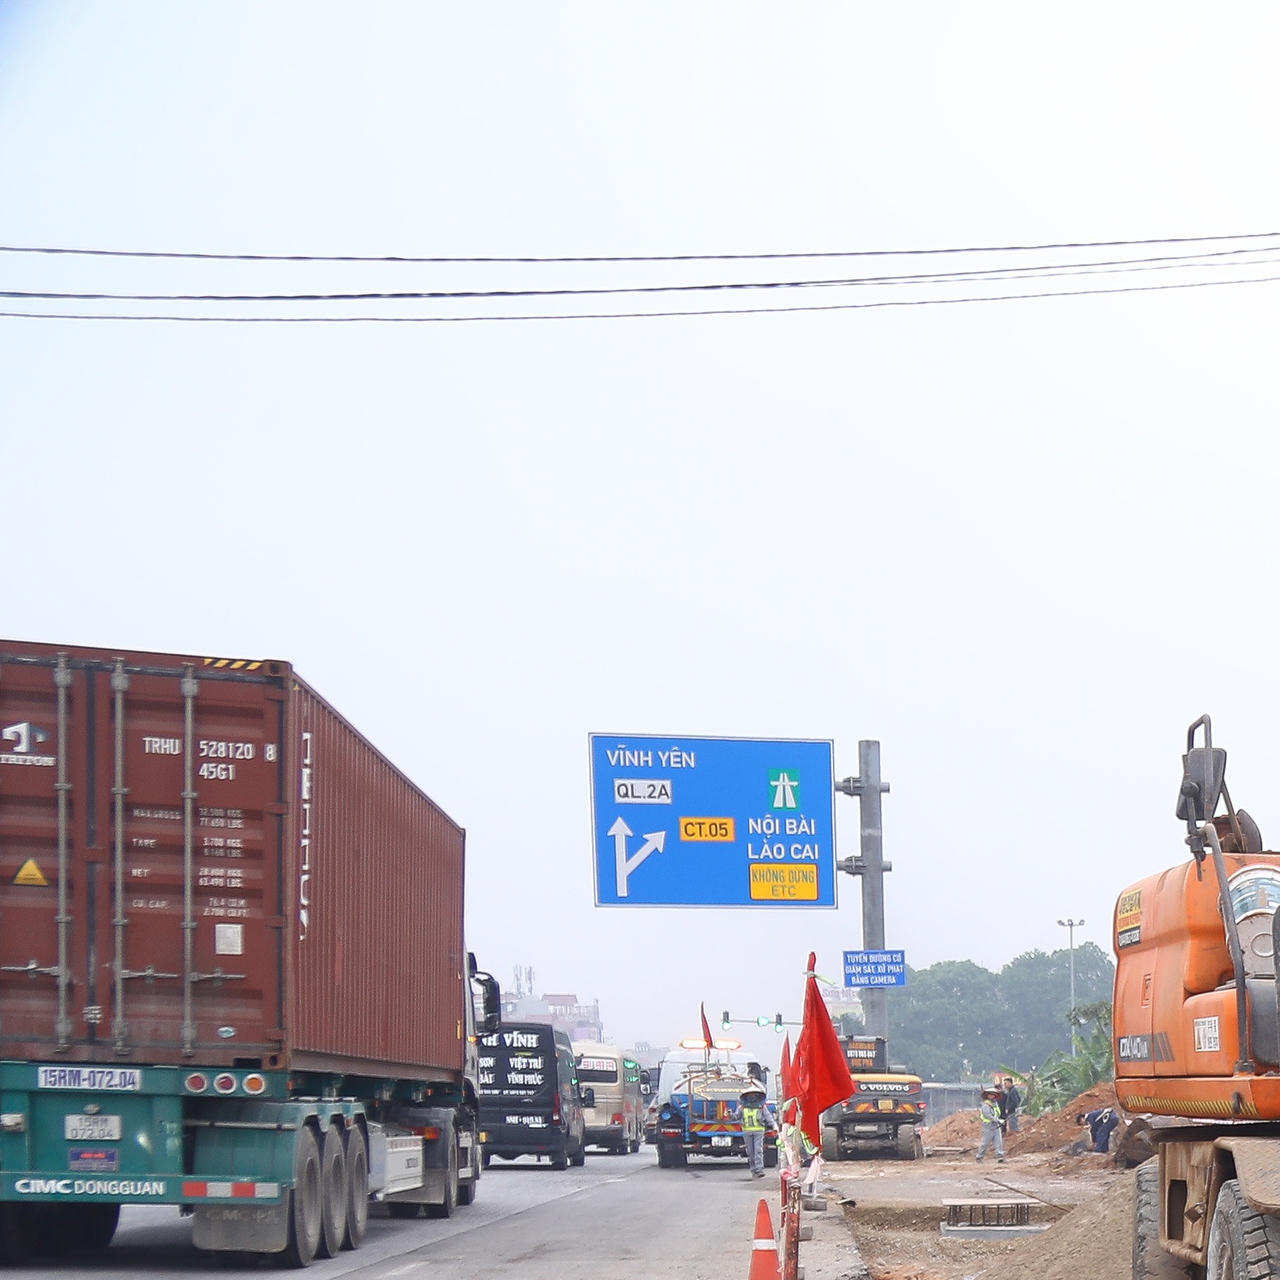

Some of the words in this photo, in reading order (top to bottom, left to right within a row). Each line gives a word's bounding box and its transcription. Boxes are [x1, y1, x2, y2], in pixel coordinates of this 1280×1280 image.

[142, 737, 182, 755] TRHU
[199, 740, 255, 760] 528120
[265, 743, 278, 762] 8
[606, 744, 653, 767] VĨNH
[657, 746, 696, 768] YÊN
[199, 763, 236, 780] 45G1
[616, 783, 670, 799] QL.2A
[684, 822, 728, 838] CT.05
[748, 815, 780, 839] NỘI
[785, 814, 816, 836] BÀI
[747, 839, 786, 860] LÀO
[790, 843, 819, 860] CAI
[752, 867, 785, 883] KHÔNG
[771, 885, 797, 897] ETC
[870, 975, 897, 985] CAMERA
[503, 1031, 539, 1048] VĨNH
[41, 1068, 137, 1089] 15RM-072.04
[867, 1083, 902, 1092] VOLVO
[78, 1117, 108, 1128] 15RM
[71, 1128, 114, 1139] 072.04
[14, 1179, 73, 1194] CIMC
[74, 1180, 166, 1196] DONGGUAN
